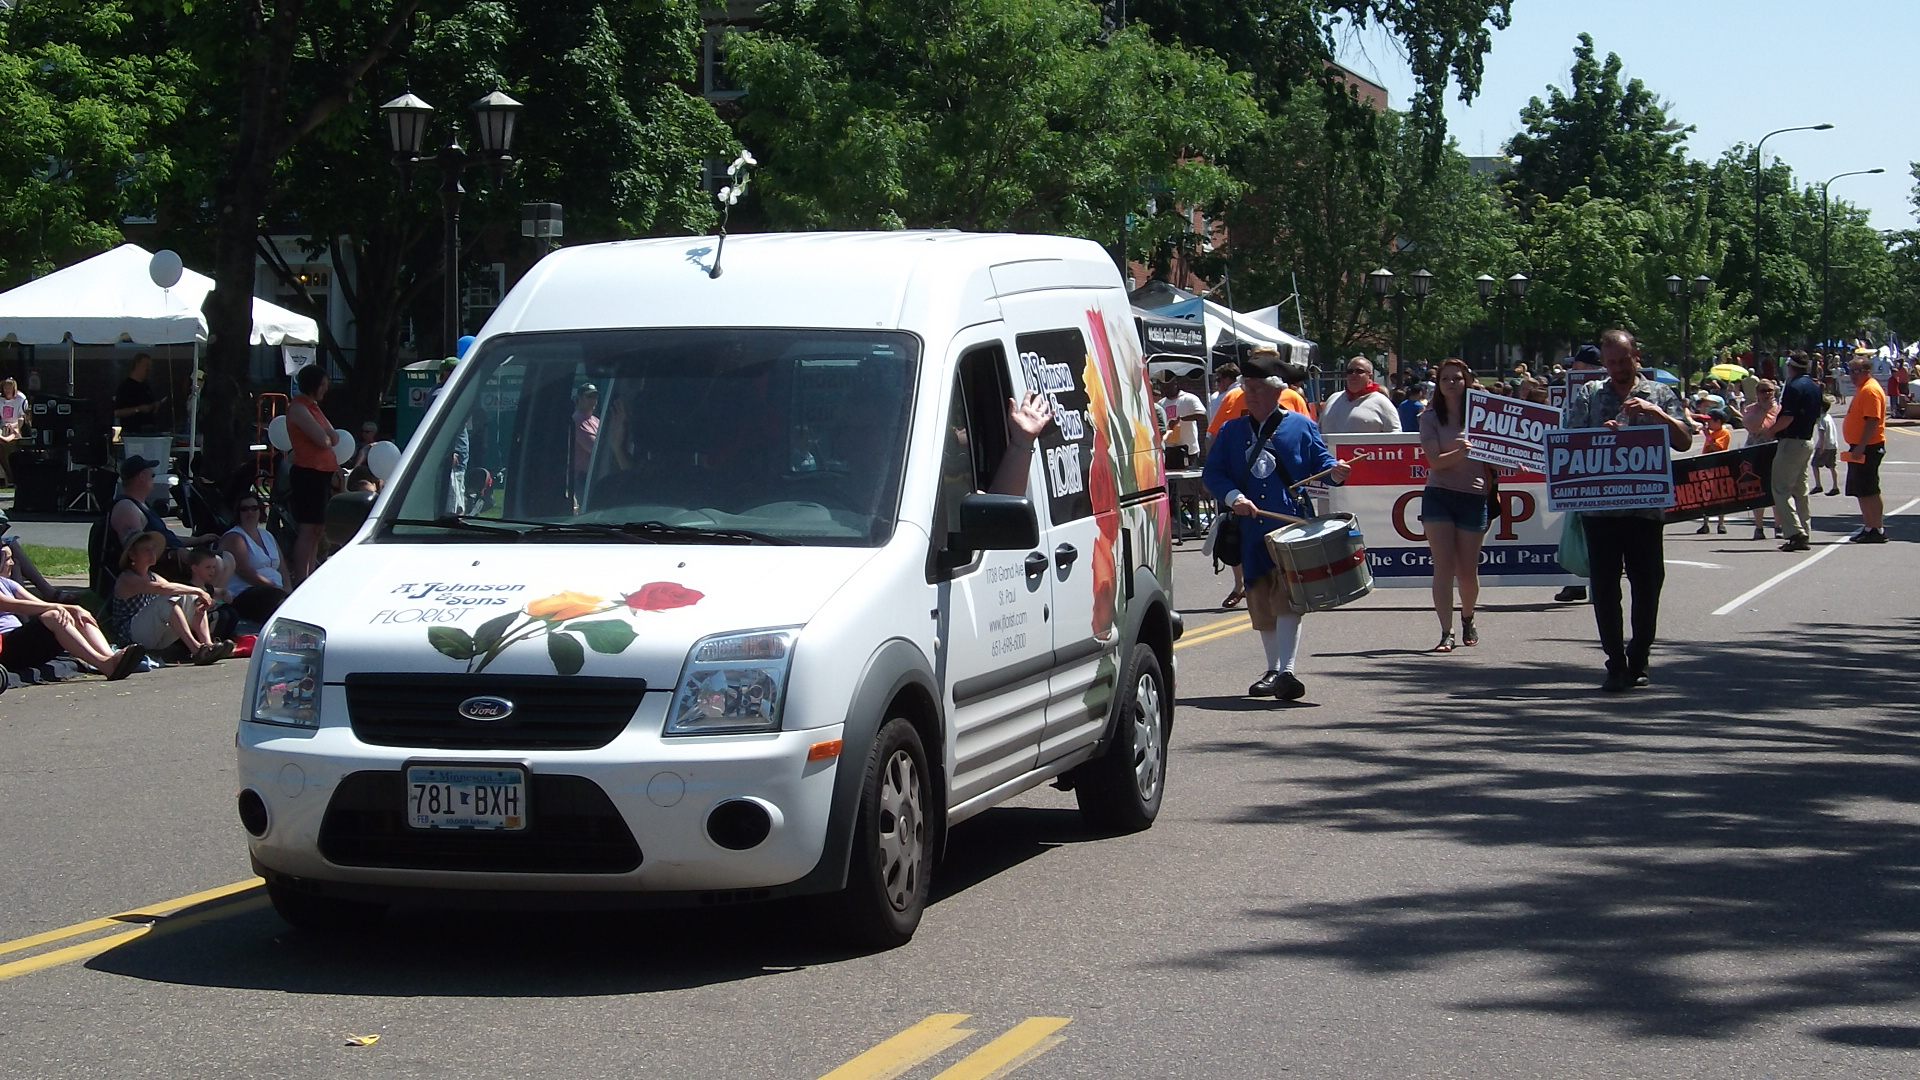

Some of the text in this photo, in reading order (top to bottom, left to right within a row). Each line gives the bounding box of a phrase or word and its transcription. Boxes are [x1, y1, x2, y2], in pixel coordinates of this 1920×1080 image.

[1472, 395, 1487, 404] VOTE
[1503, 404, 1523, 415] LIZZ
[1058, 405, 1084, 440] Sons
[1550, 435, 1569, 443] VOTE
[1592, 435, 1616, 446] LIZZ
[1353, 447, 1403, 460] Saint
[1471, 439, 1489, 449] SAINT
[1490, 443, 1506, 453] PAUL
[1507, 447, 1531, 459] SCHOOL
[1552, 446, 1663, 475] PAULSON
[1047, 443, 1083, 498] FLORIST
[1688, 466, 1730, 482] KEVIN
[1554, 483, 1664, 497] SAINT PAUL SCHOOL BOARD
[1555, 497, 1665, 508] WWW.PAULSON4SCHOOLS.COM
[1517, 550, 1559, 564] Part
[998, 564, 1014, 581] Grand
[407, 582, 526, 599] Johnson
[1005, 588, 1017, 603] Paul
[445, 596, 509, 605] Sons
[368, 607, 475, 625] FLORIST
[470, 702, 499, 715] Ford
[440, 771, 492, 782] Minnesota
[413, 784, 518, 815] 781 BXH
